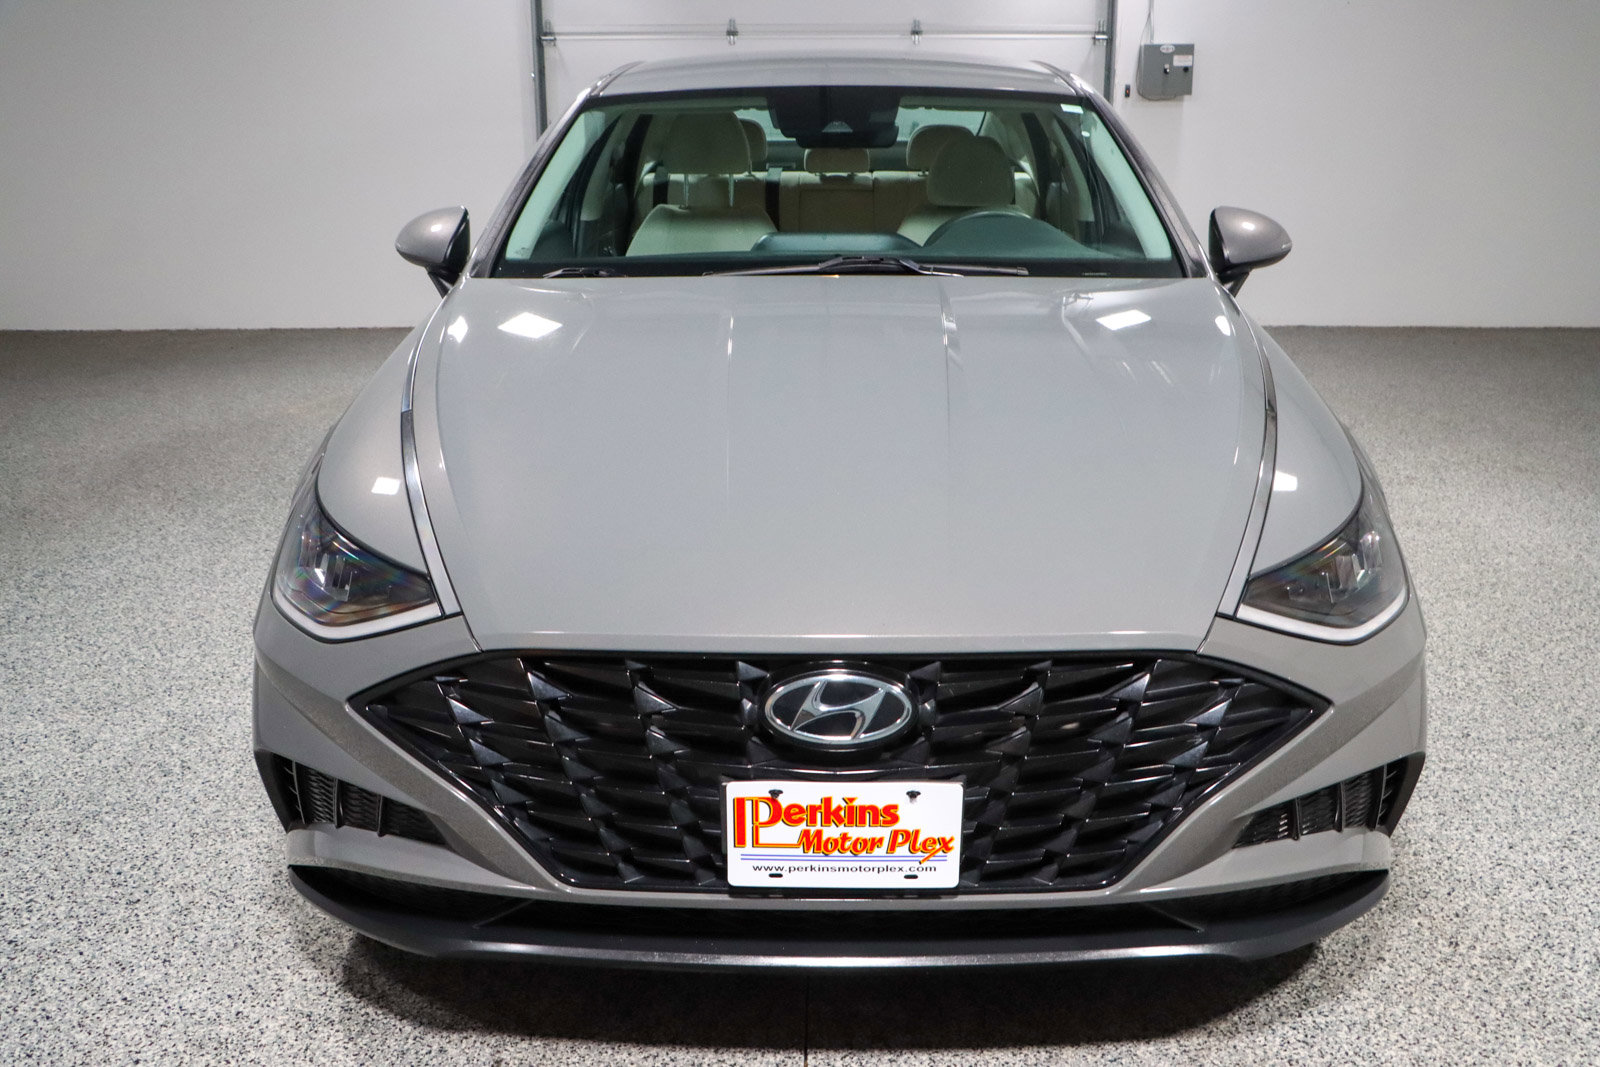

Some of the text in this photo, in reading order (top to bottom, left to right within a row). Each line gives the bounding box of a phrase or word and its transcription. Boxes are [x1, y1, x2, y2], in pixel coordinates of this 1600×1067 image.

[733, 796, 899, 848] Perkins
[798, 829, 954, 864] Motor Plex
[752, 865, 937, 873] www.perkinsmotorplex.com
